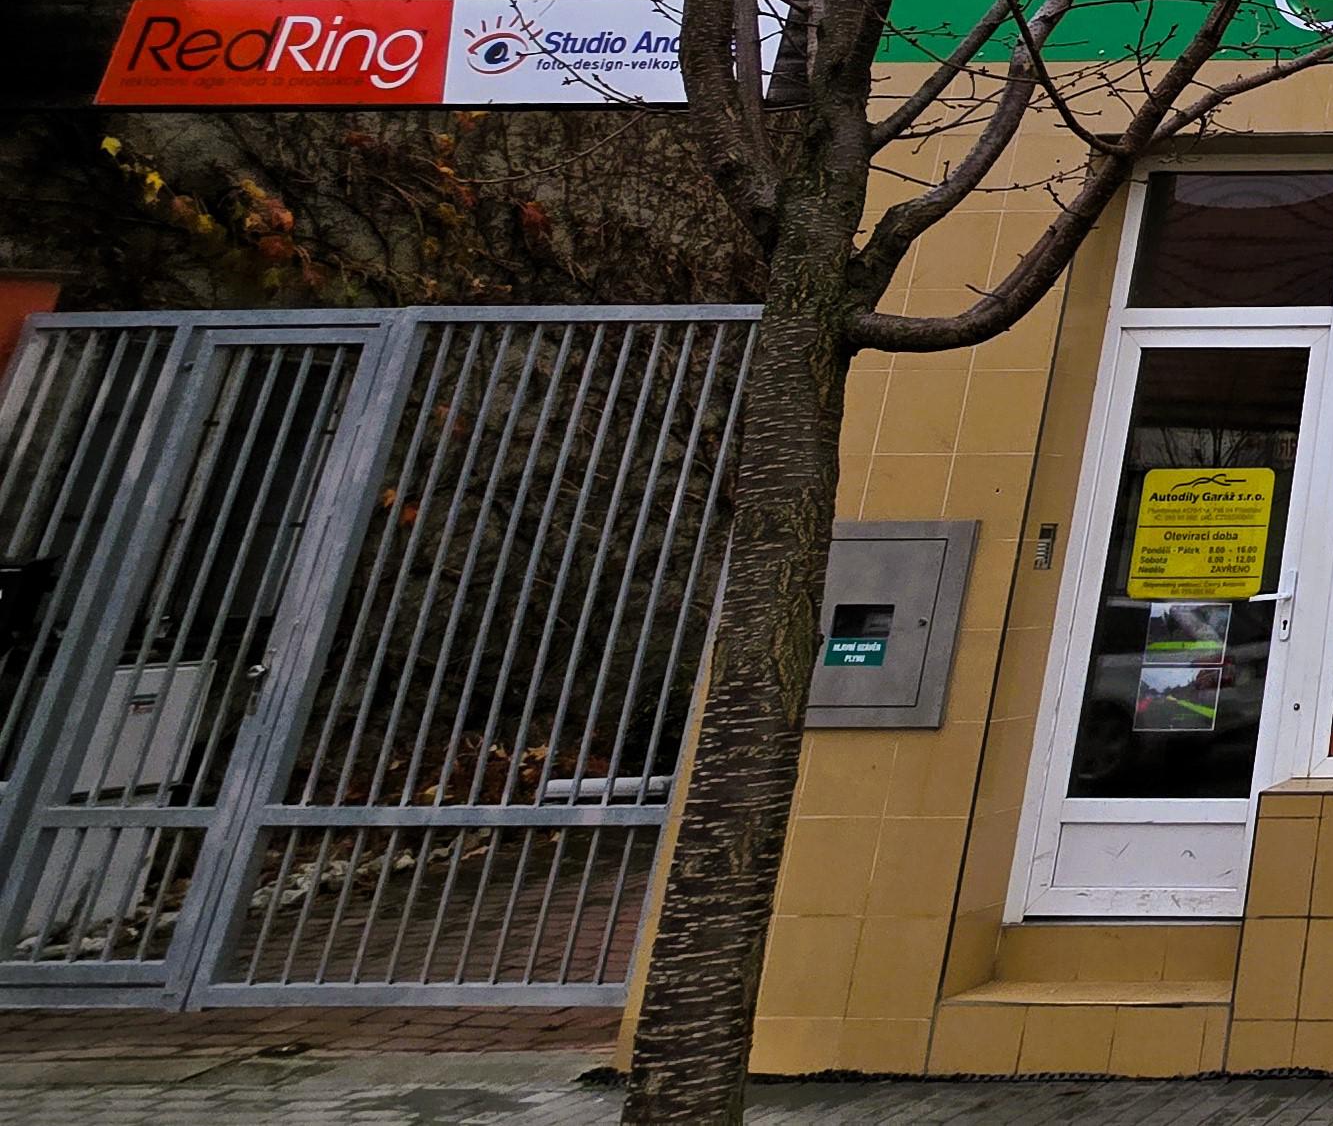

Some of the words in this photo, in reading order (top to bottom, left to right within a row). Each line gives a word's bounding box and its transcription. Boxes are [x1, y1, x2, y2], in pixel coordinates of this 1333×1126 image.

[543, 31, 627, 54] Studio
[1149, 492, 1200, 504] Autodíly
[1202, 491, 1235, 502] Garáž
[1238, 493, 1265, 502] s.r.o.
[1212, 530, 1239, 541] doba
